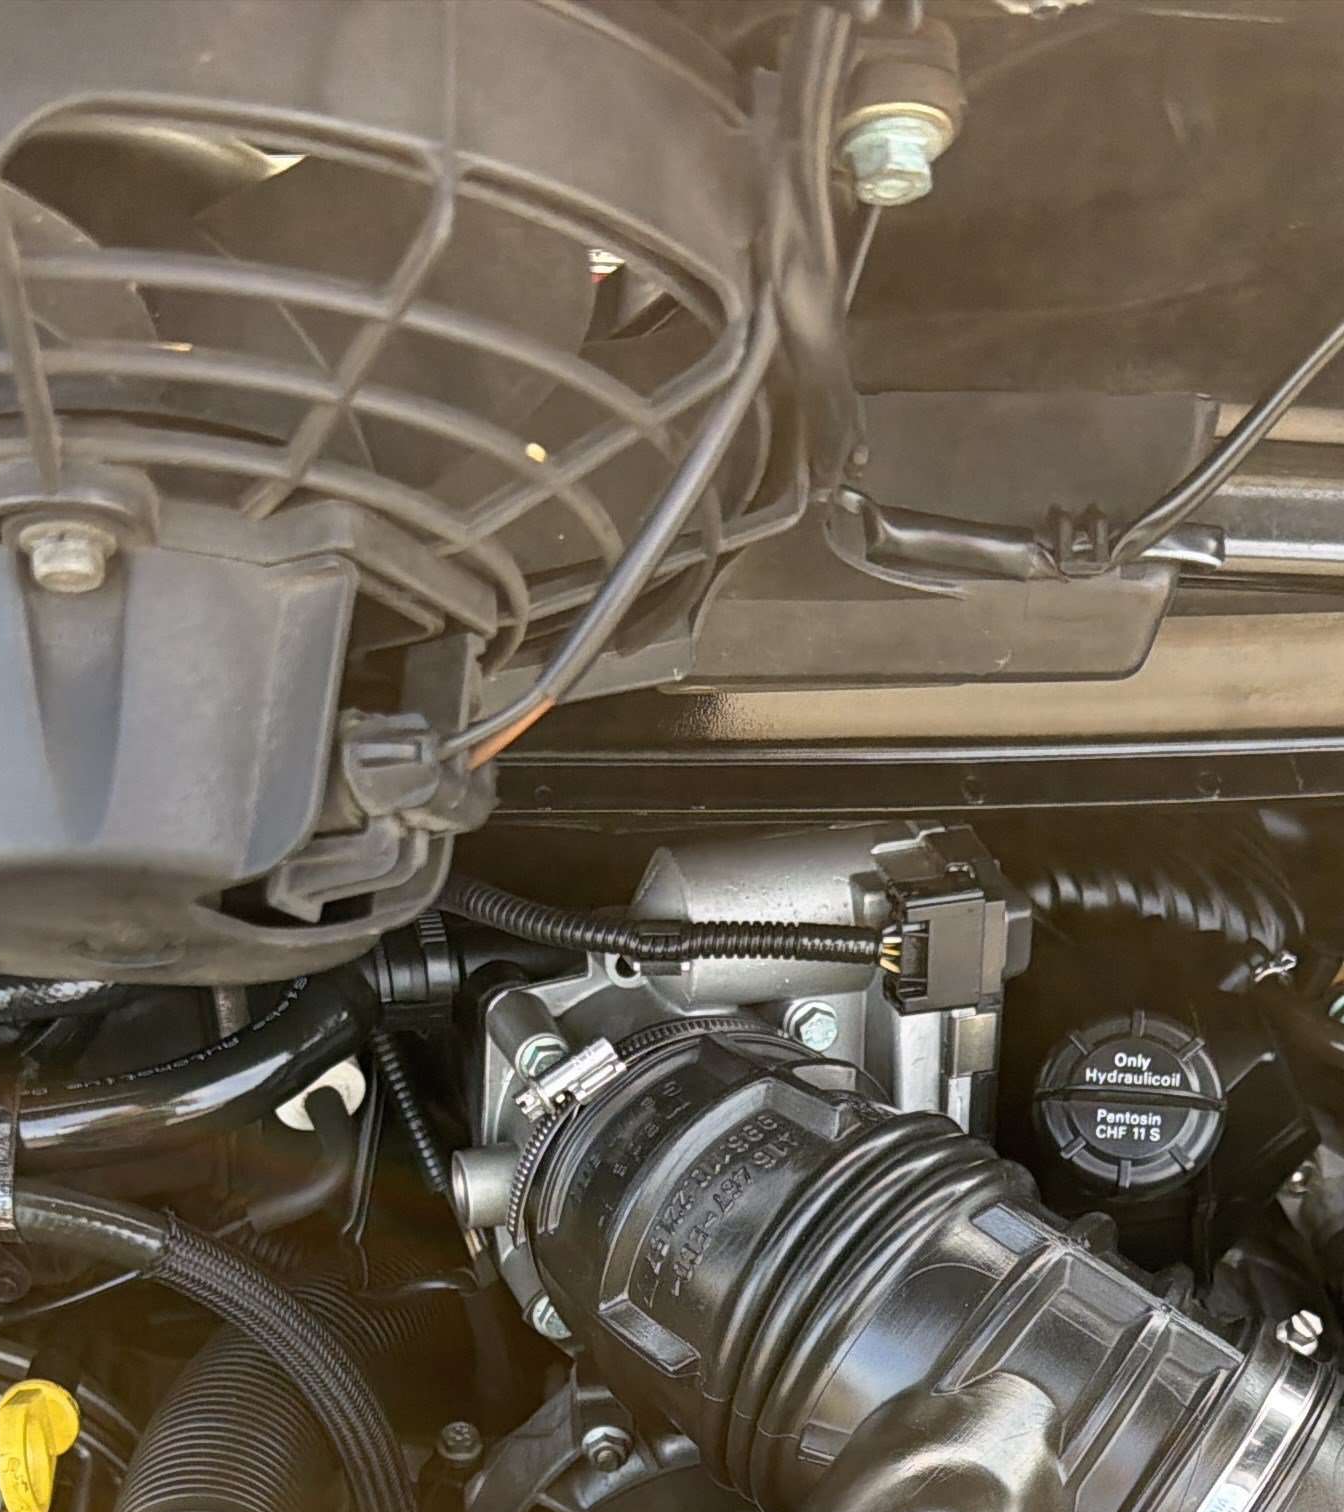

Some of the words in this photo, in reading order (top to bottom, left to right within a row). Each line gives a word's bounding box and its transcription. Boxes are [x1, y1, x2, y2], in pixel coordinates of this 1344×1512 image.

[1114, 1053, 1151, 1071] Only
[1086, 1068, 1181, 1087] Hydraulicoil
[1097, 1109, 1162, 1126] Pentosin
[1096, 1126, 1127, 1140] CHF
[1133, 1127, 1146, 1140] 11
[1149, 1127, 1161, 1141] S
